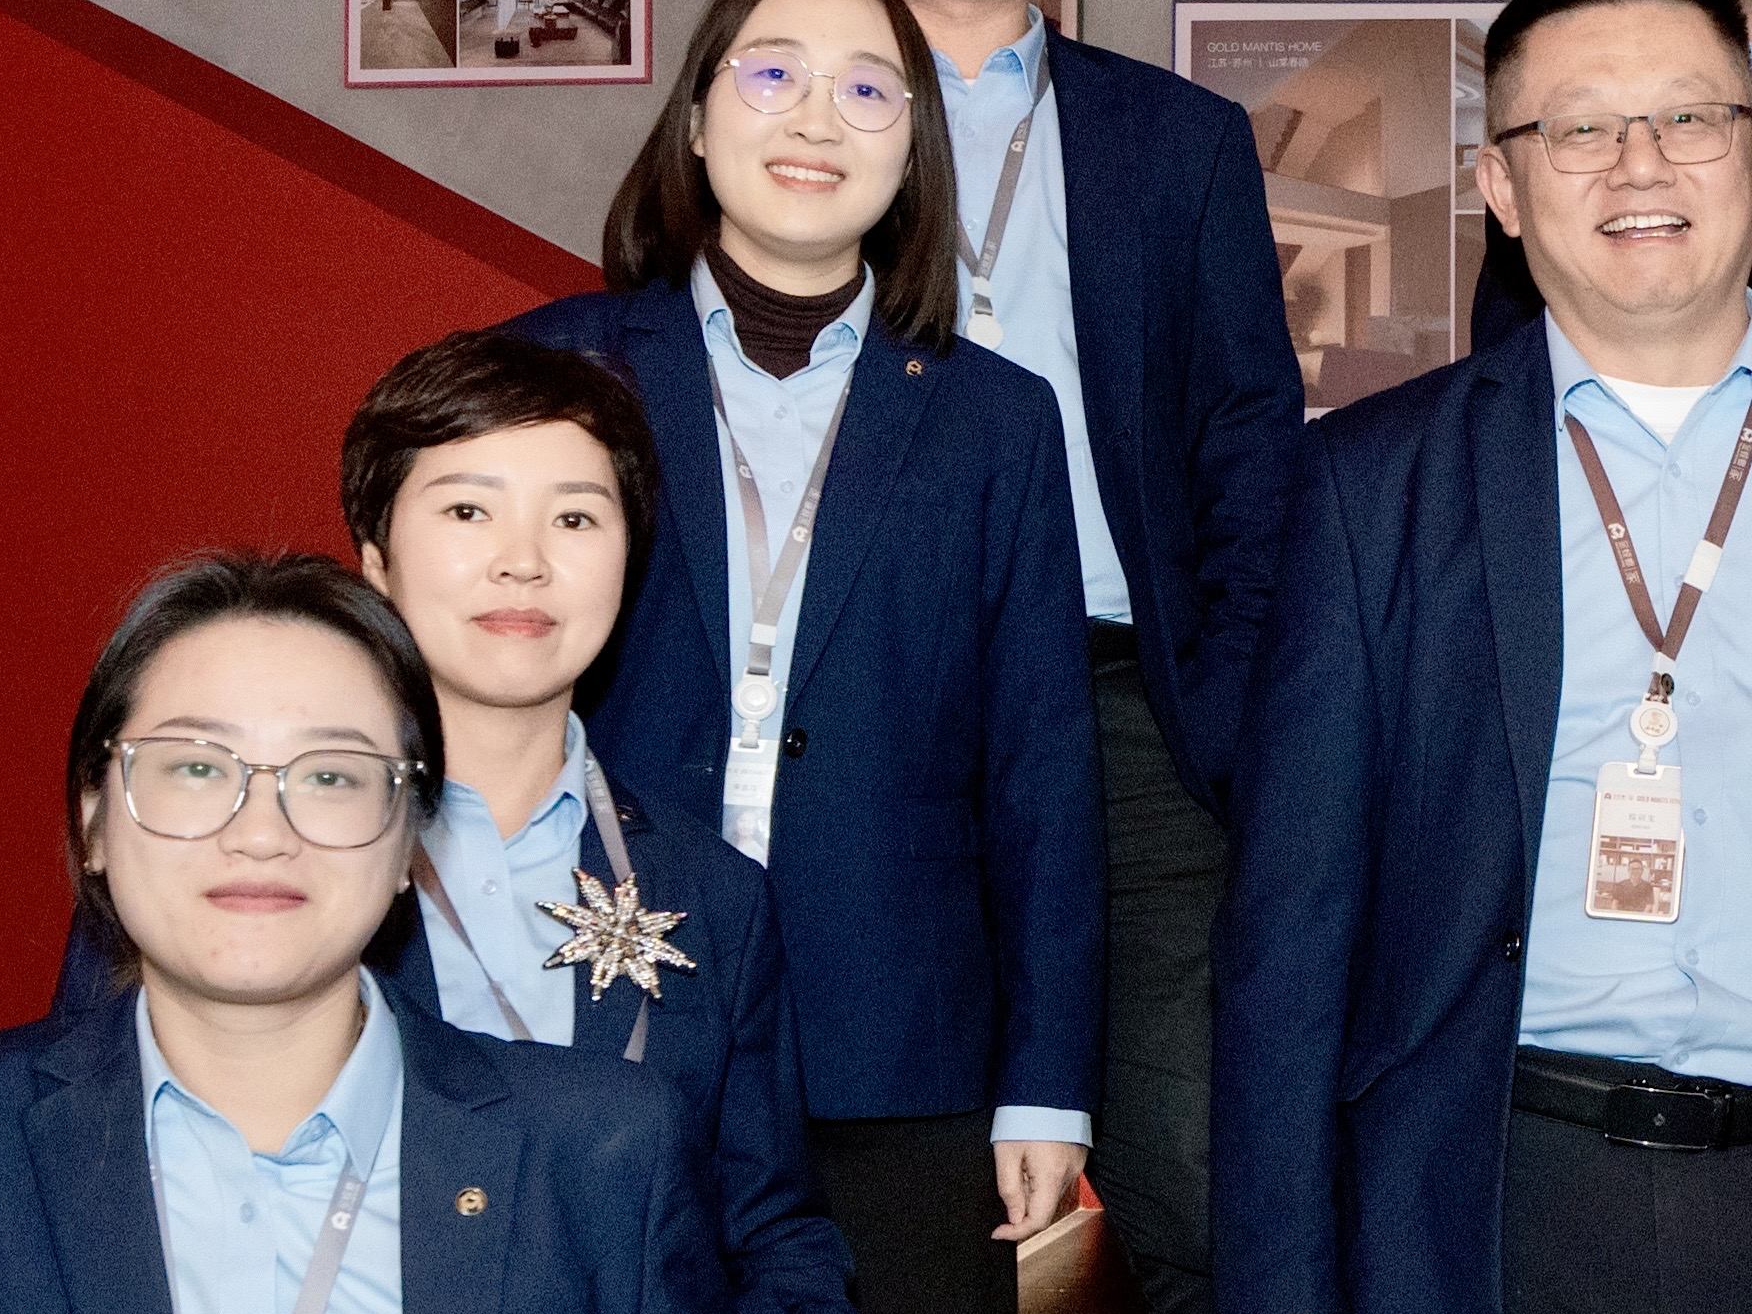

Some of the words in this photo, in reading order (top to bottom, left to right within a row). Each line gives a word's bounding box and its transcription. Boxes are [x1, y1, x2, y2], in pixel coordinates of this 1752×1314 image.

[1206, 42, 1240, 53] GOLD
[1242, 41, 1286, 52] MANTIS
[1288, 40, 1323, 52] HOME
